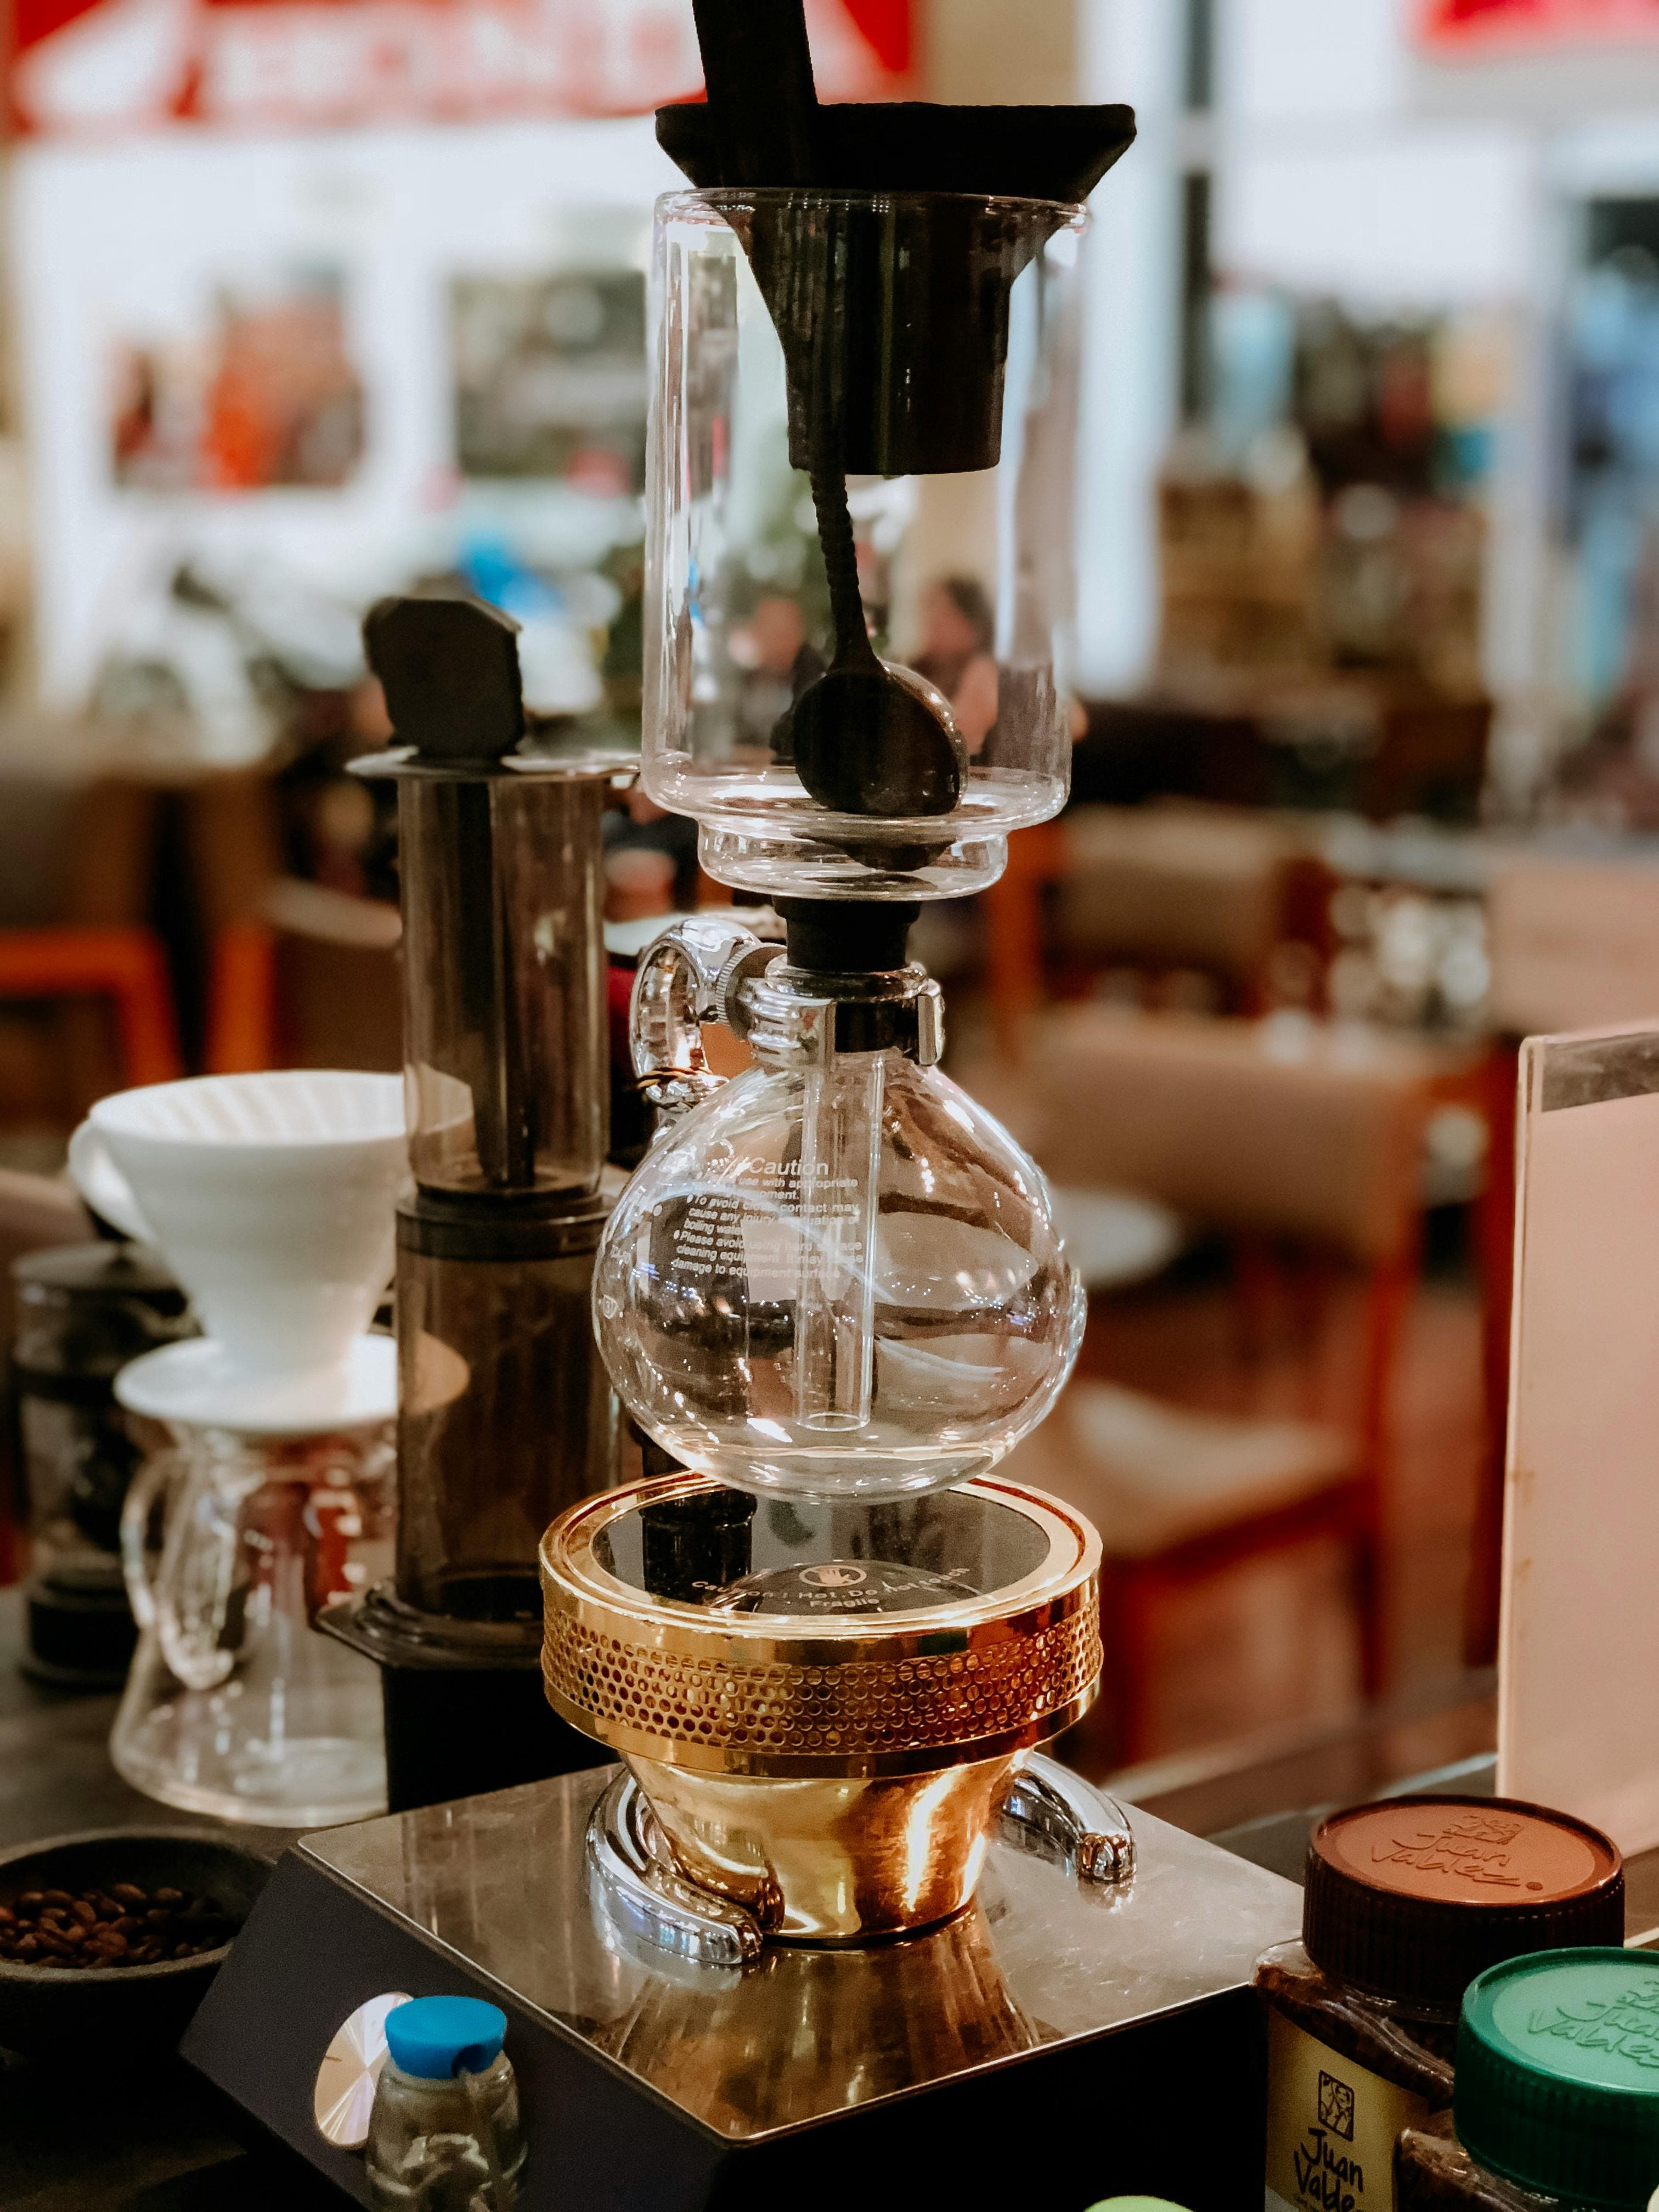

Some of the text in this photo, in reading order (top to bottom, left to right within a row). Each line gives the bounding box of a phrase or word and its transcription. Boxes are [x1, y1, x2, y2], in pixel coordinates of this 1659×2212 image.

[749, 1157, 829, 1176] Caution
[763, 1177, 785, 1188] with
[708, 1198, 740, 1209] avoid
[780, 1202, 827, 1213] contact
[689, 1208, 718, 1220] cause
[720, 1212, 740, 1224] any
[684, 1218, 715, 1235] boiling
[680, 1230, 714, 1246] Please
[716, 1238, 745, 1249] avoid
[676, 1244, 718, 1261] cleaning
[672, 1257, 713, 1274] damage
[715, 1263, 726, 1274] to
[692, 1581, 774, 1598] Cauon
[918, 1568, 970, 1586] touch
[810, 1598, 880, 1607] Fragile
[1392, 1833, 1511, 1867] Juan
[1300, 2127, 1364, 2193] Juan
[1293, 2149, 1365, 2212] Valde
